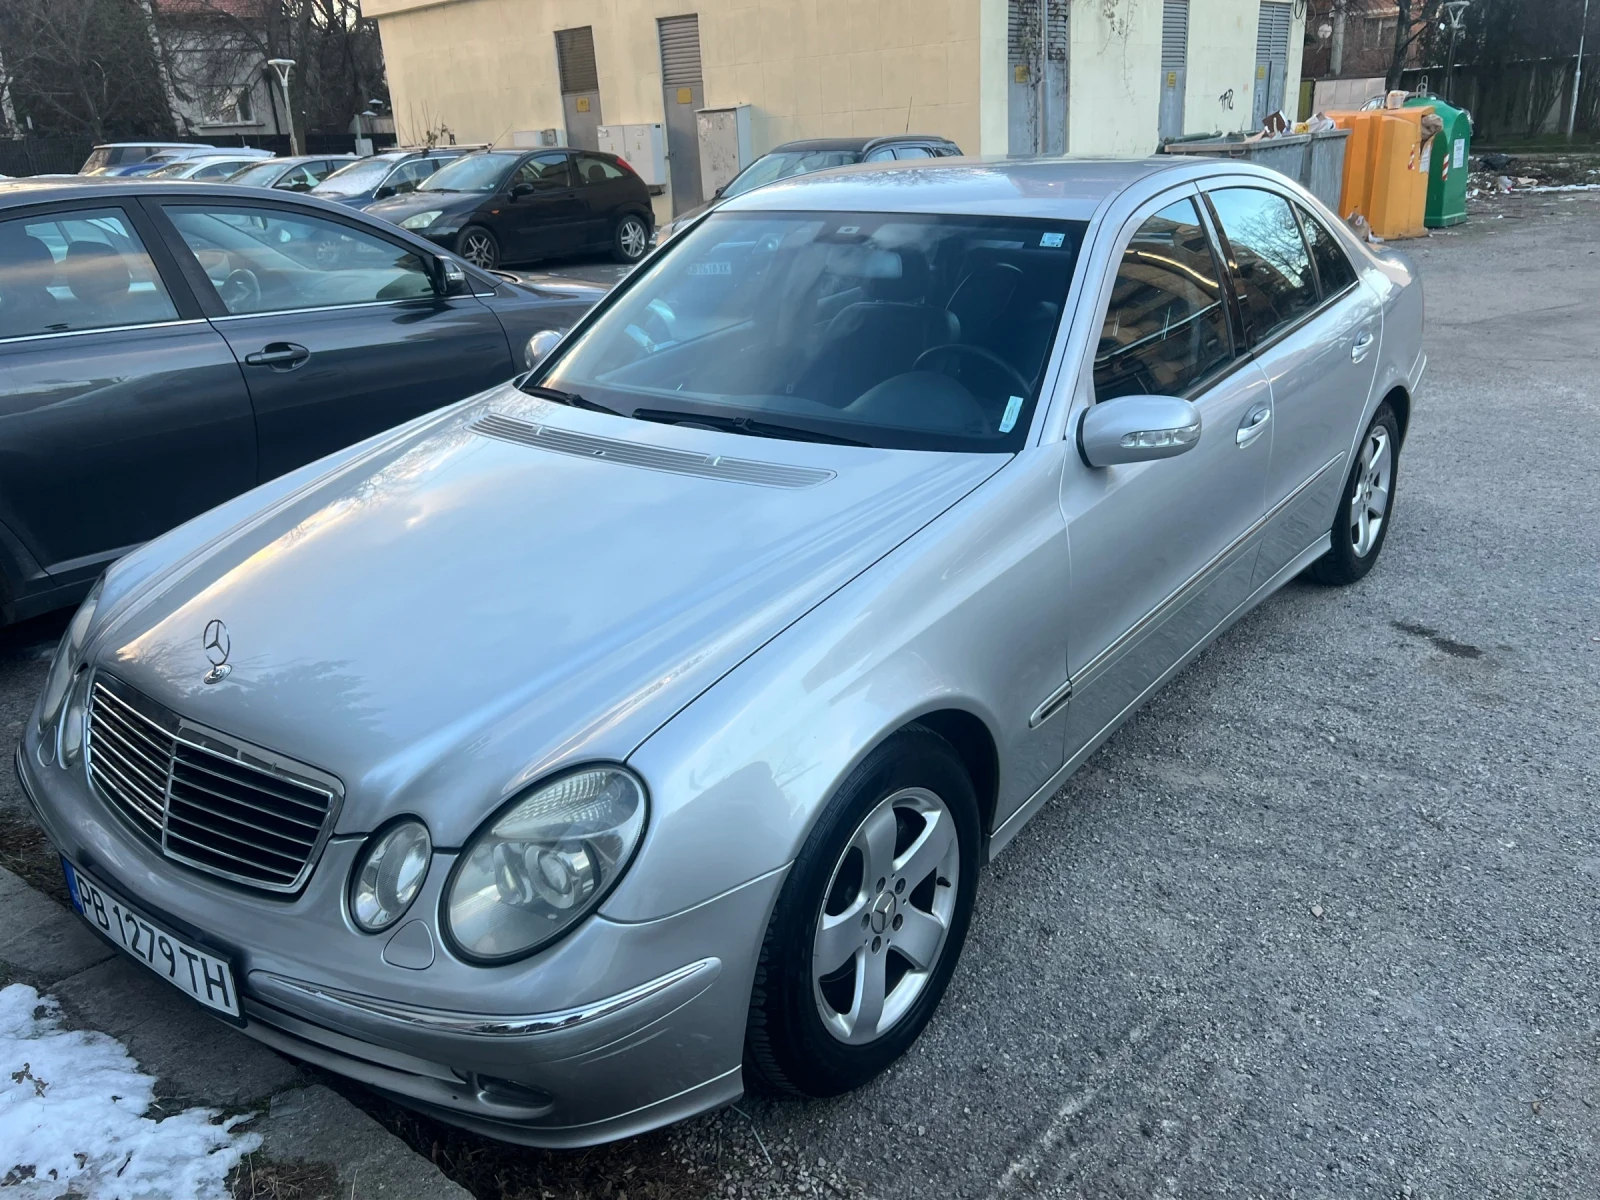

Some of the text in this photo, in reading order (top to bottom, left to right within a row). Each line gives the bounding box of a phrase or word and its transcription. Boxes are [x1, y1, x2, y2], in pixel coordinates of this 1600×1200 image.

[75, 873, 231, 1008] PB 1279 TH
